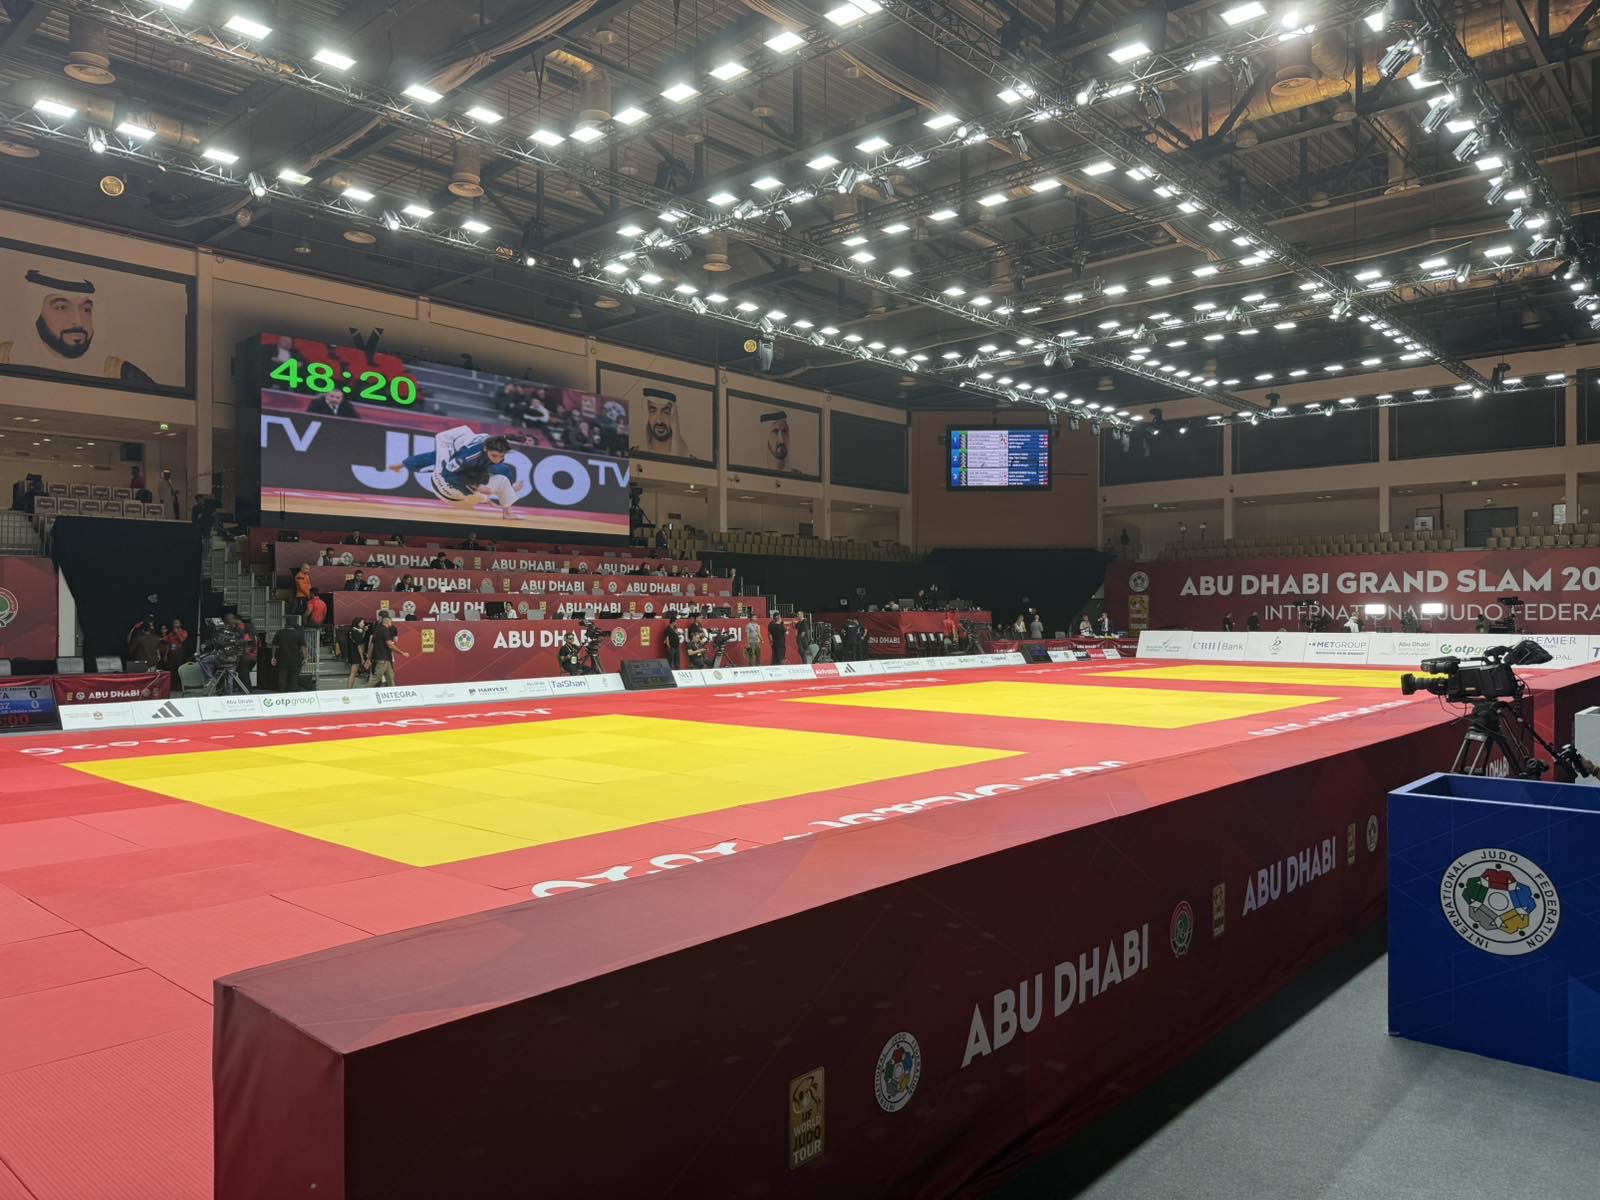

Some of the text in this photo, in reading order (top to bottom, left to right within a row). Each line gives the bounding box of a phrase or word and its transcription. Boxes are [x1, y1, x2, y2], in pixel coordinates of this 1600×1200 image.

[270, 358, 416, 405] 48:20
[367, 554, 440, 567] ABU DHA
[491, 559, 556, 571] ABU DHABI
[598, 563, 618, 574] ABU
[395, 577, 471, 590] AU DHABI
[521, 580, 585, 592] ABU DHABI
[1180, 566, 1600, 596] ABU DHABI GRAND SLAM 20
[626, 583, 680, 593] ABU DHABI
[429, 602, 460, 614] ABU
[557, 603, 621, 614] ABU DHABI
[1438, 603, 1503, 621] JUDO
[493, 630, 592, 649] ABU DHAB
[1317, 641, 1367, 649] METGROUP
[1222, 642, 1244, 651] Bank
[1455, 645, 1485, 655] otpgr
[478, 686, 508, 694] HARVEST
[552, 680, 586, 688] TaiShan
[29, 690, 37, 699] 0
[88, 689, 140, 699] ABU DHABI
[381, 690, 418, 700] INTEGRA
[31, 700, 39, 708] 0
[275, 696, 316, 708] otpgroup
[1242, 858, 1283, 918] ABU
[1286, 835, 1337, 894] DHABI
[1443, 850, 1558, 949] INTERNATIONAL JUDO FEDERATION
[960, 922, 1150, 1070] ABU DHABI
[793, 1115, 822, 1137] WORLD
[793, 1126, 821, 1150] JUDO
[793, 1139, 822, 1165] TOUR
